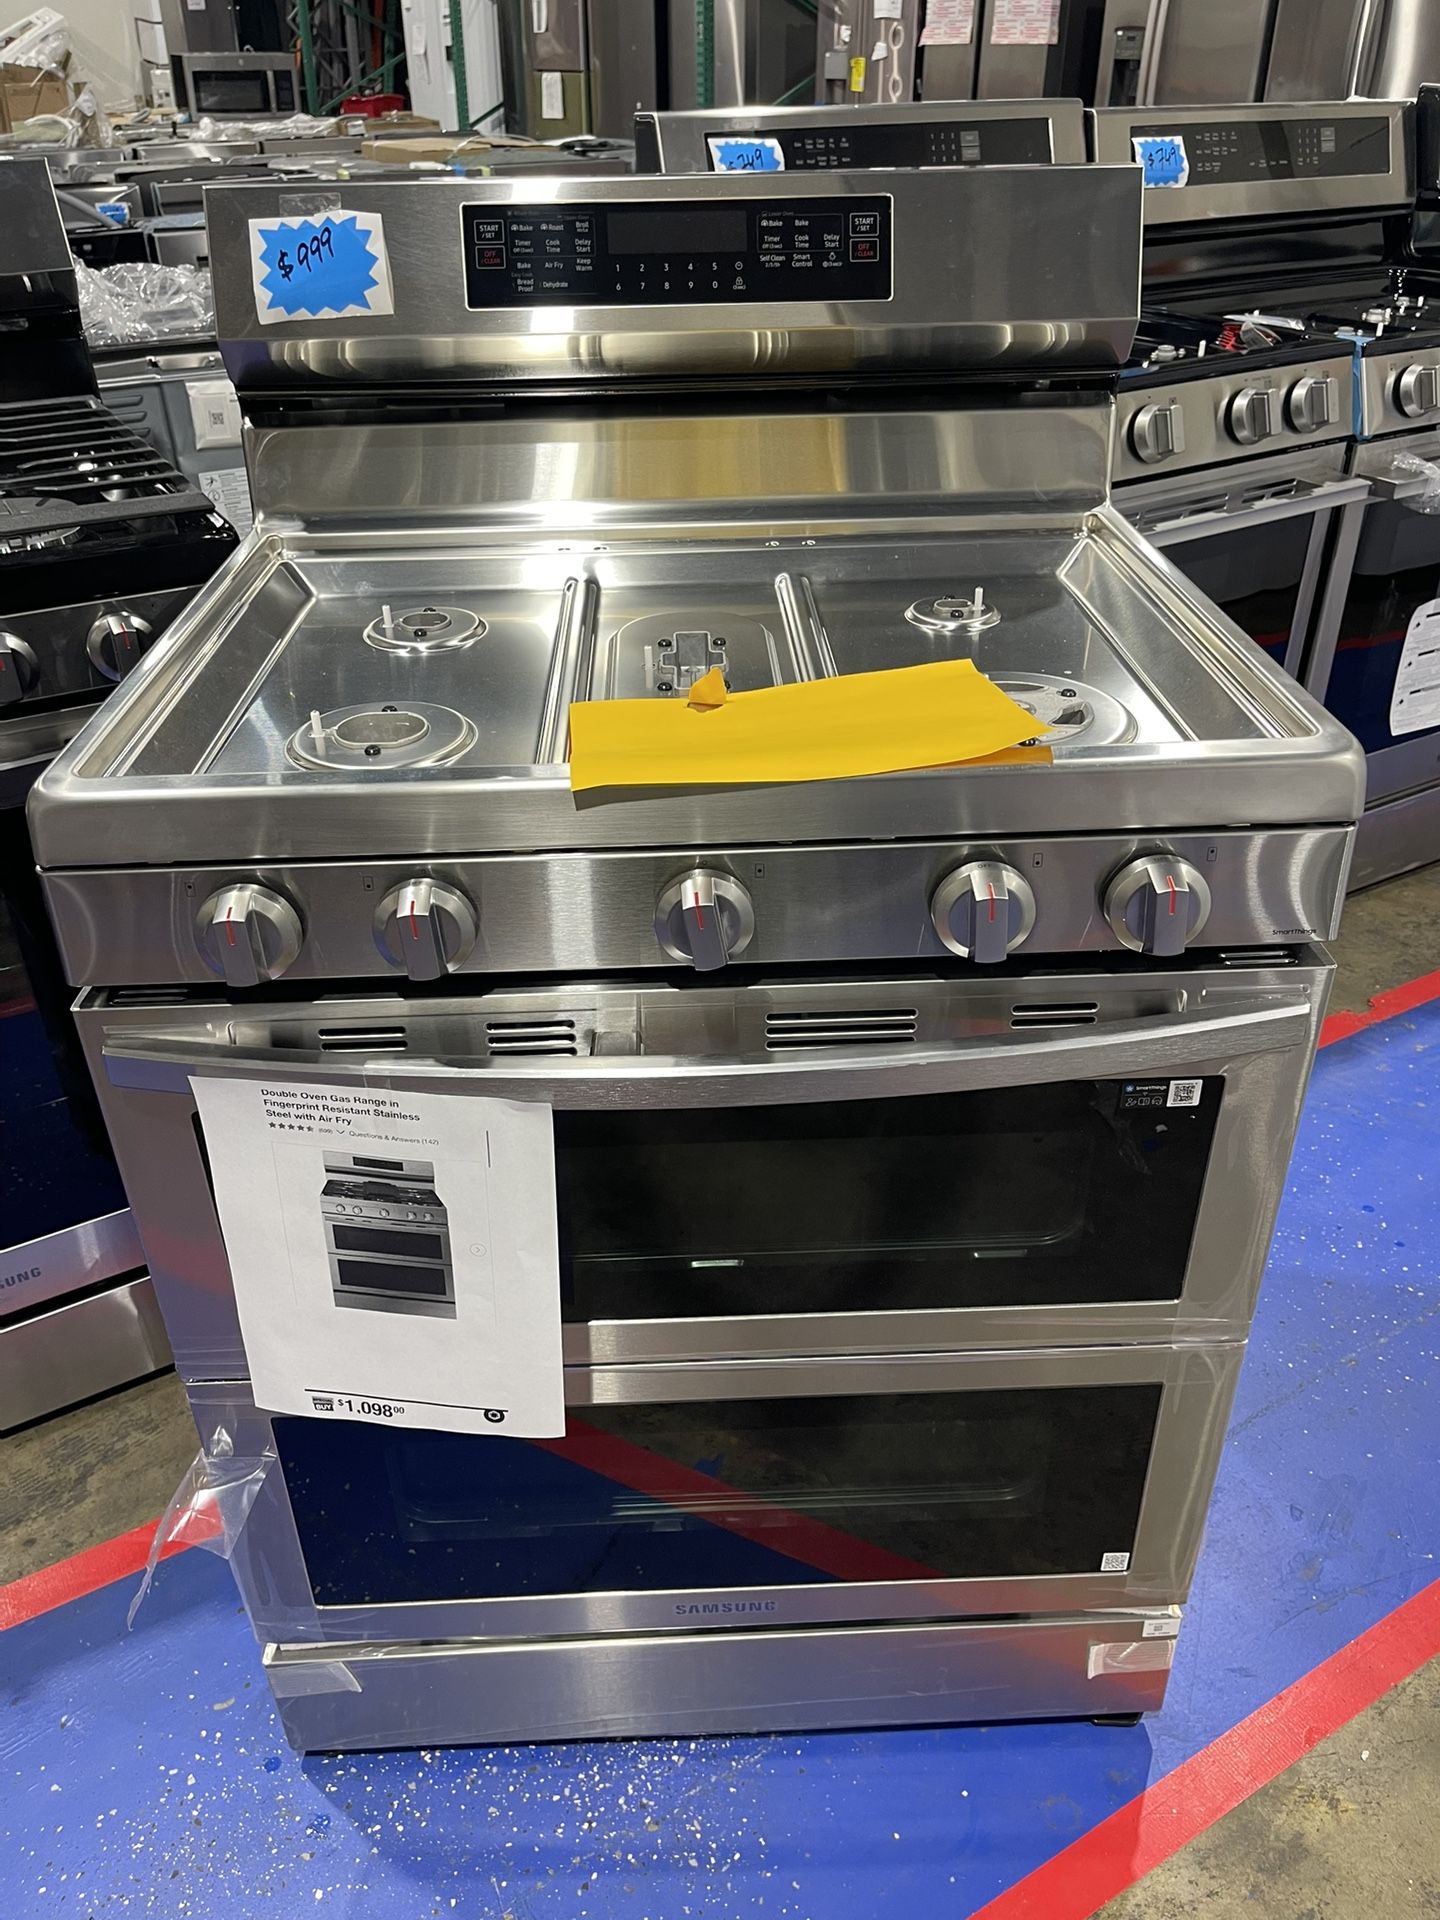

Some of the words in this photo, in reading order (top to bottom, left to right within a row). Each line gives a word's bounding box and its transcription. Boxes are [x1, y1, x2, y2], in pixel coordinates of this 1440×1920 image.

[1148, 147, 1177, 171] $749
[278, 226, 334, 282] $999
[616, 264, 620, 272] 1
[640, 264, 644, 272] 2
[664, 263, 668, 271] 3
[688, 263, 693, 271] 4
[712, 262, 717, 271] 5
[616, 283, 621, 291] 6
[640, 282, 645, 290] 7
[664, 282, 670, 290] 8
[689, 281, 694, 289] 9
[713, 281, 718, 289] 0
[1272, 928, 1317, 936] SmartThings
[260, 1088, 298, 1099] Double
[300, 1092, 328, 1102] Oven
[329, 1094, 351, 1103] Gas
[353, 1096, 387, 1108] Range
[389, 1099, 399, 1108] in
[263, 1099, 320, 1114] Fingerprint
[322, 1104, 371, 1116] Resistant
[373, 1109, 421, 1122] Stainless
[265, 1109, 292, 1119] Steel
[293, 1112, 316, 1122] with
[318, 1114, 333, 1124] Air
[335, 1116, 352, 1127] Fry
[349, 1130, 383, 1140] Questions
[391, 1135, 421, 1144] Answers
[421, 1137, 440, 1146] (142)
[0, 1267, 42, 1289] UNG
[675, 1601, 776, 1615] SAMSUNG
